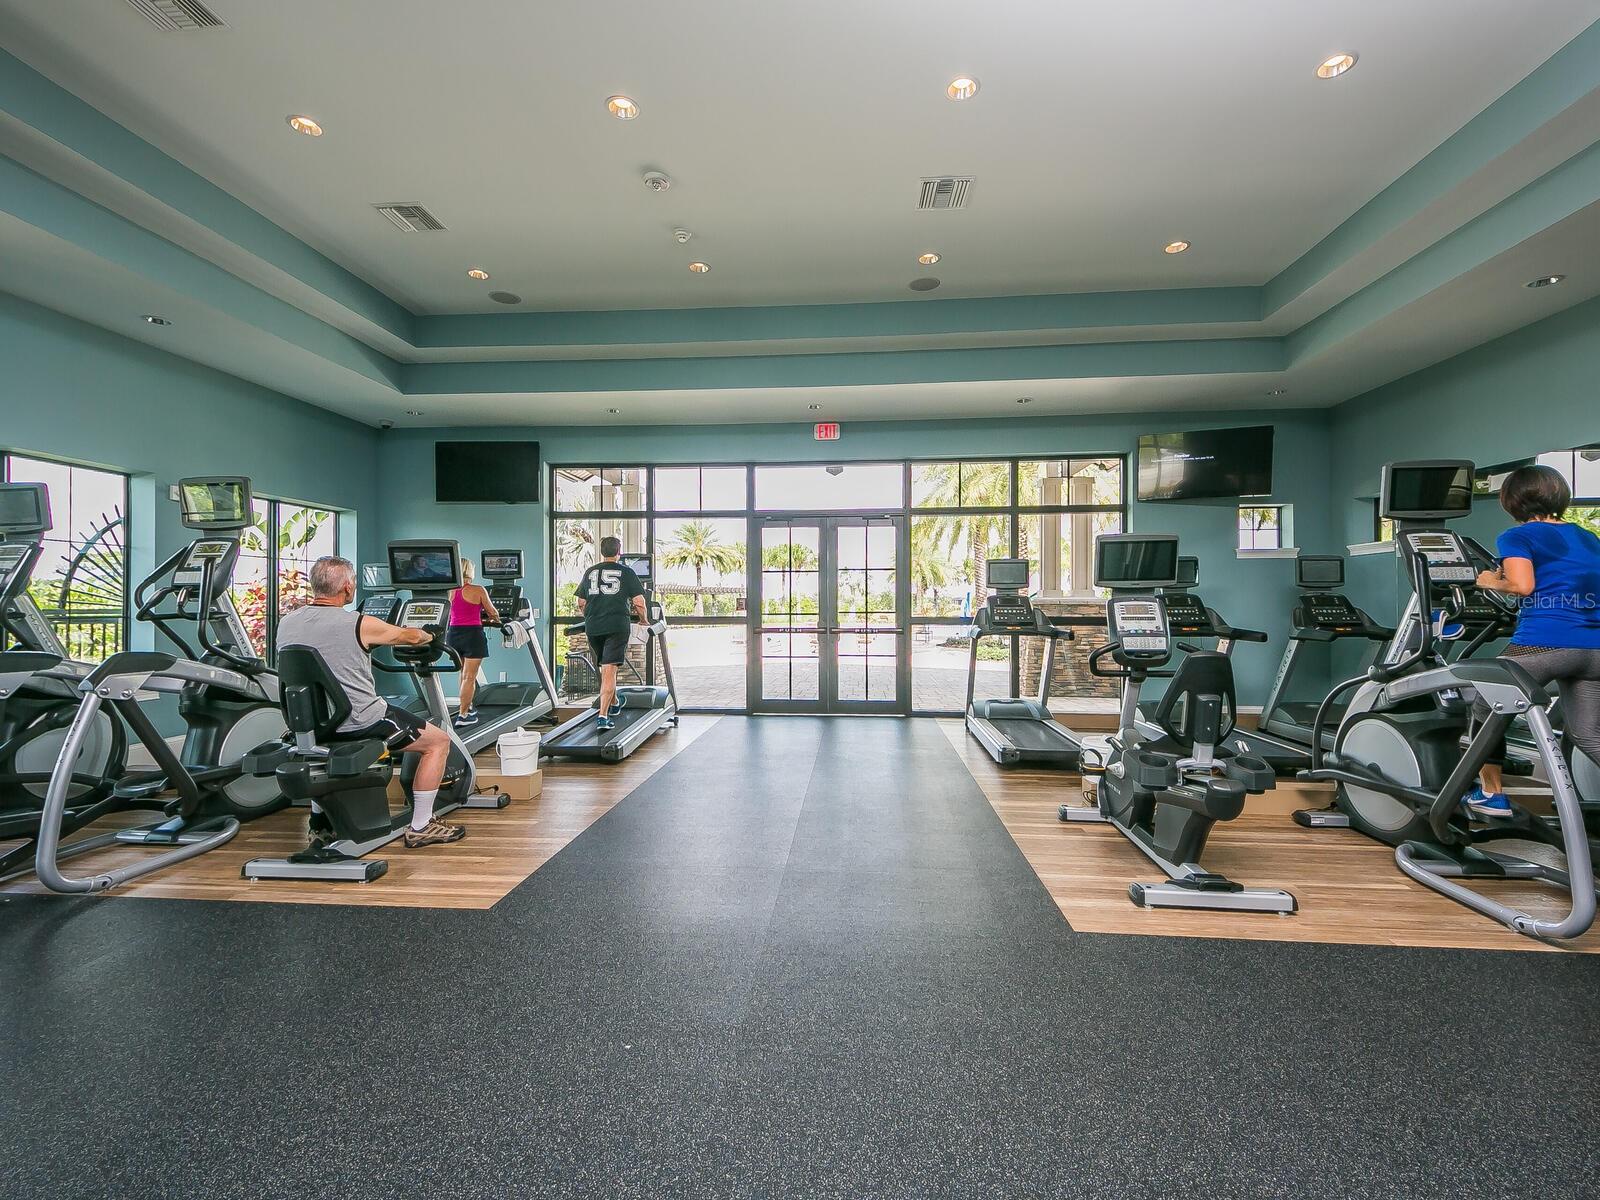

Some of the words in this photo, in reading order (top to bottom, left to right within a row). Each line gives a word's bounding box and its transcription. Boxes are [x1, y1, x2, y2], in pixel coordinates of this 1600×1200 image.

[818, 424, 837, 439] EXIT
[588, 569, 622, 595] 15
[1546, 737, 1574, 790] MATRIX
